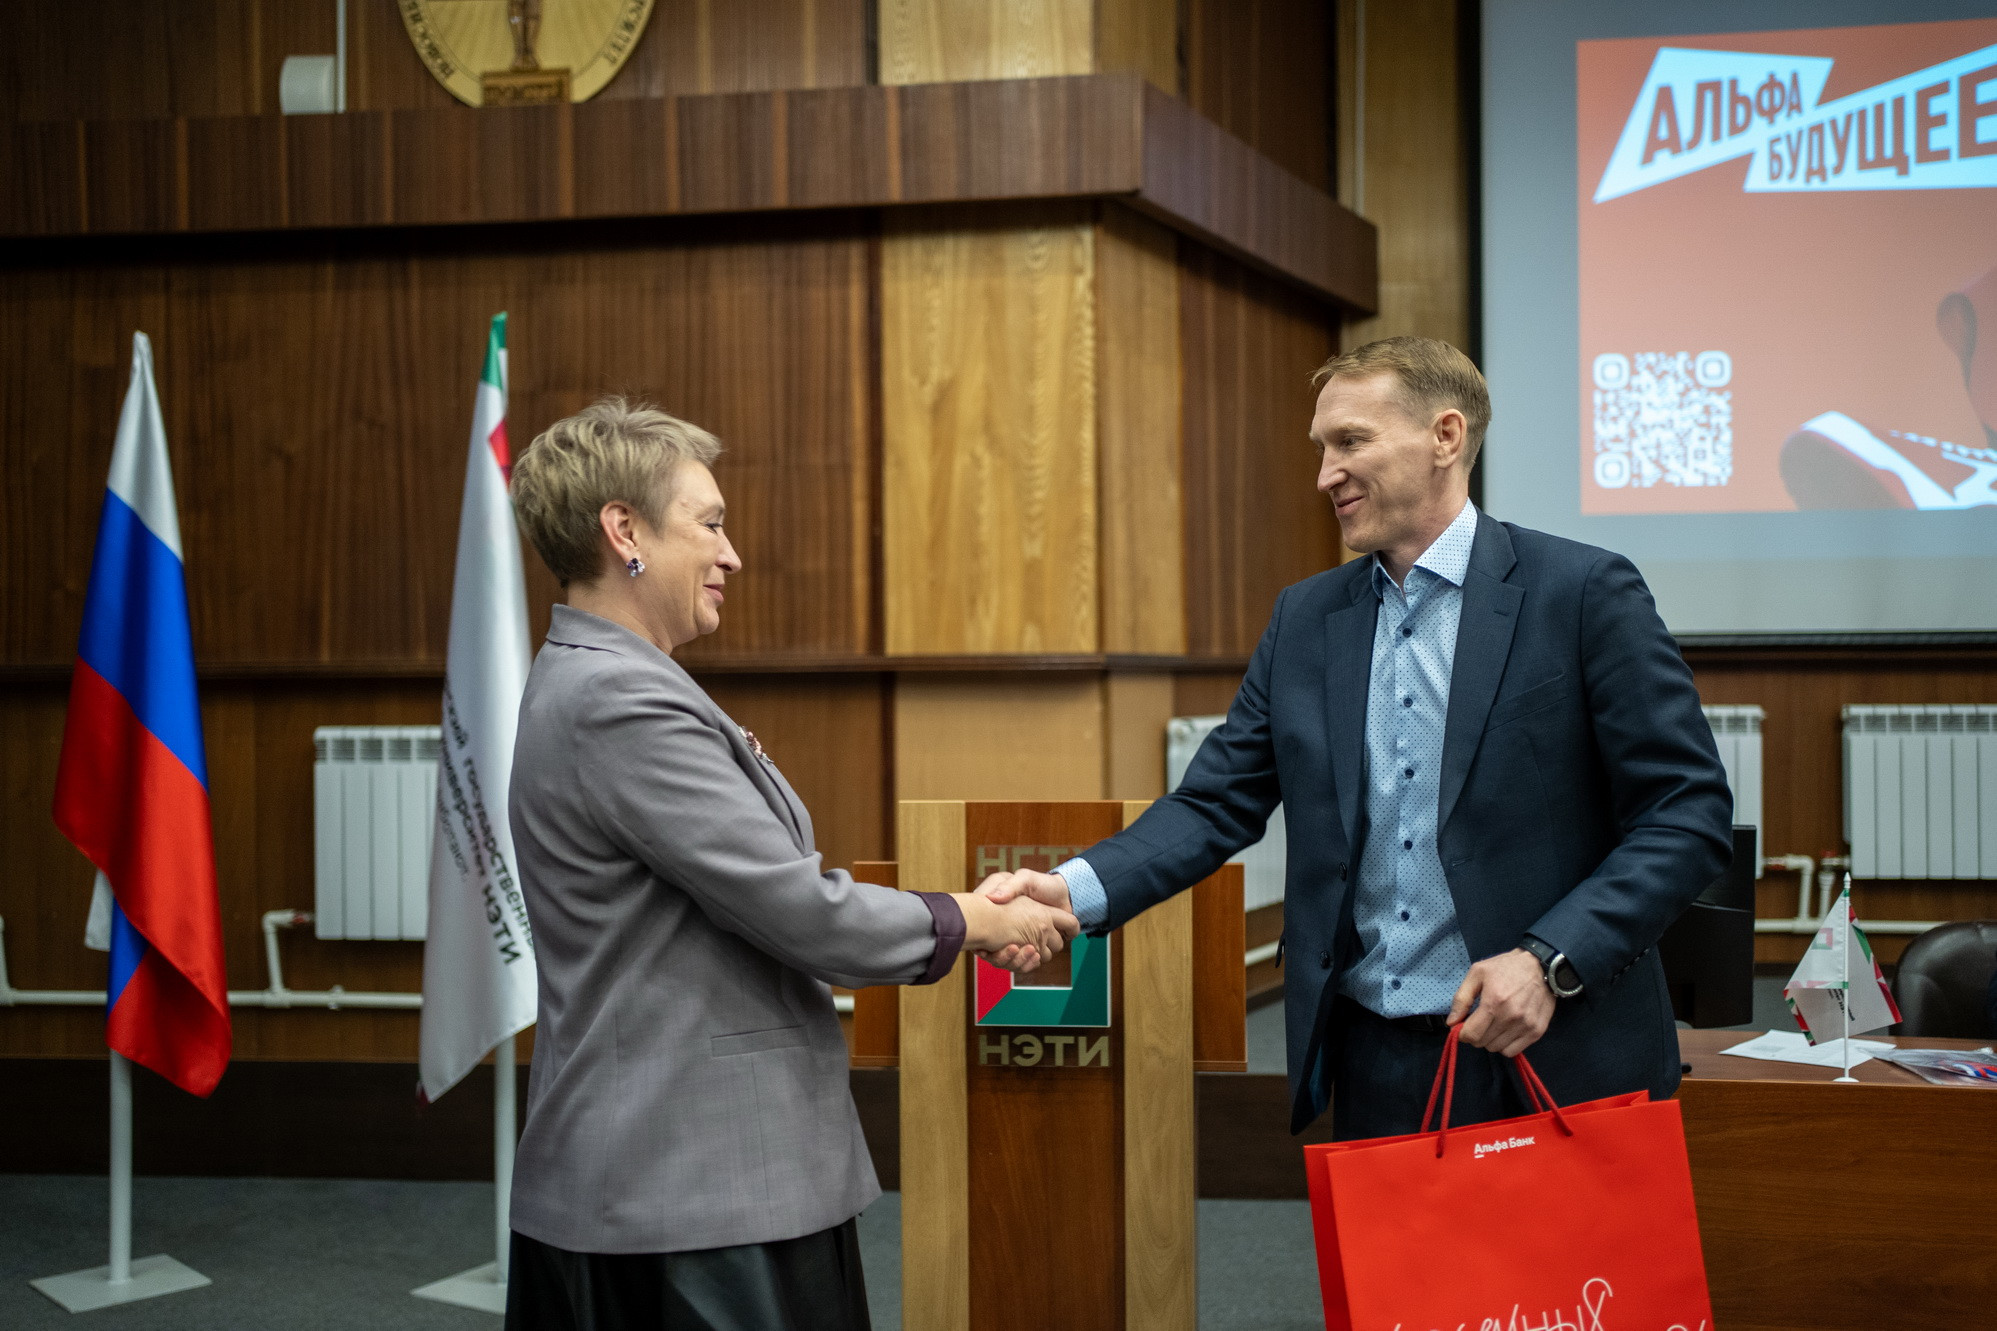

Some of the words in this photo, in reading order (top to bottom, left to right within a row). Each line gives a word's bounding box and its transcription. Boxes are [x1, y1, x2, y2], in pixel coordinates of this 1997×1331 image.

[1641, 71, 1802, 166] АЛЬФА
[1769, 64, 1997, 184] БУДУЩЕЕ
[463, 756, 533, 950] государственн
[977, 847, 1086, 878] НГТ
[482, 884, 522, 965] НЭТИ
[978, 1034, 1110, 1067] НЭТИ
[1474, 1140, 1509, 1158] Альфа
[1508, 1136, 1535, 1148] Банк
